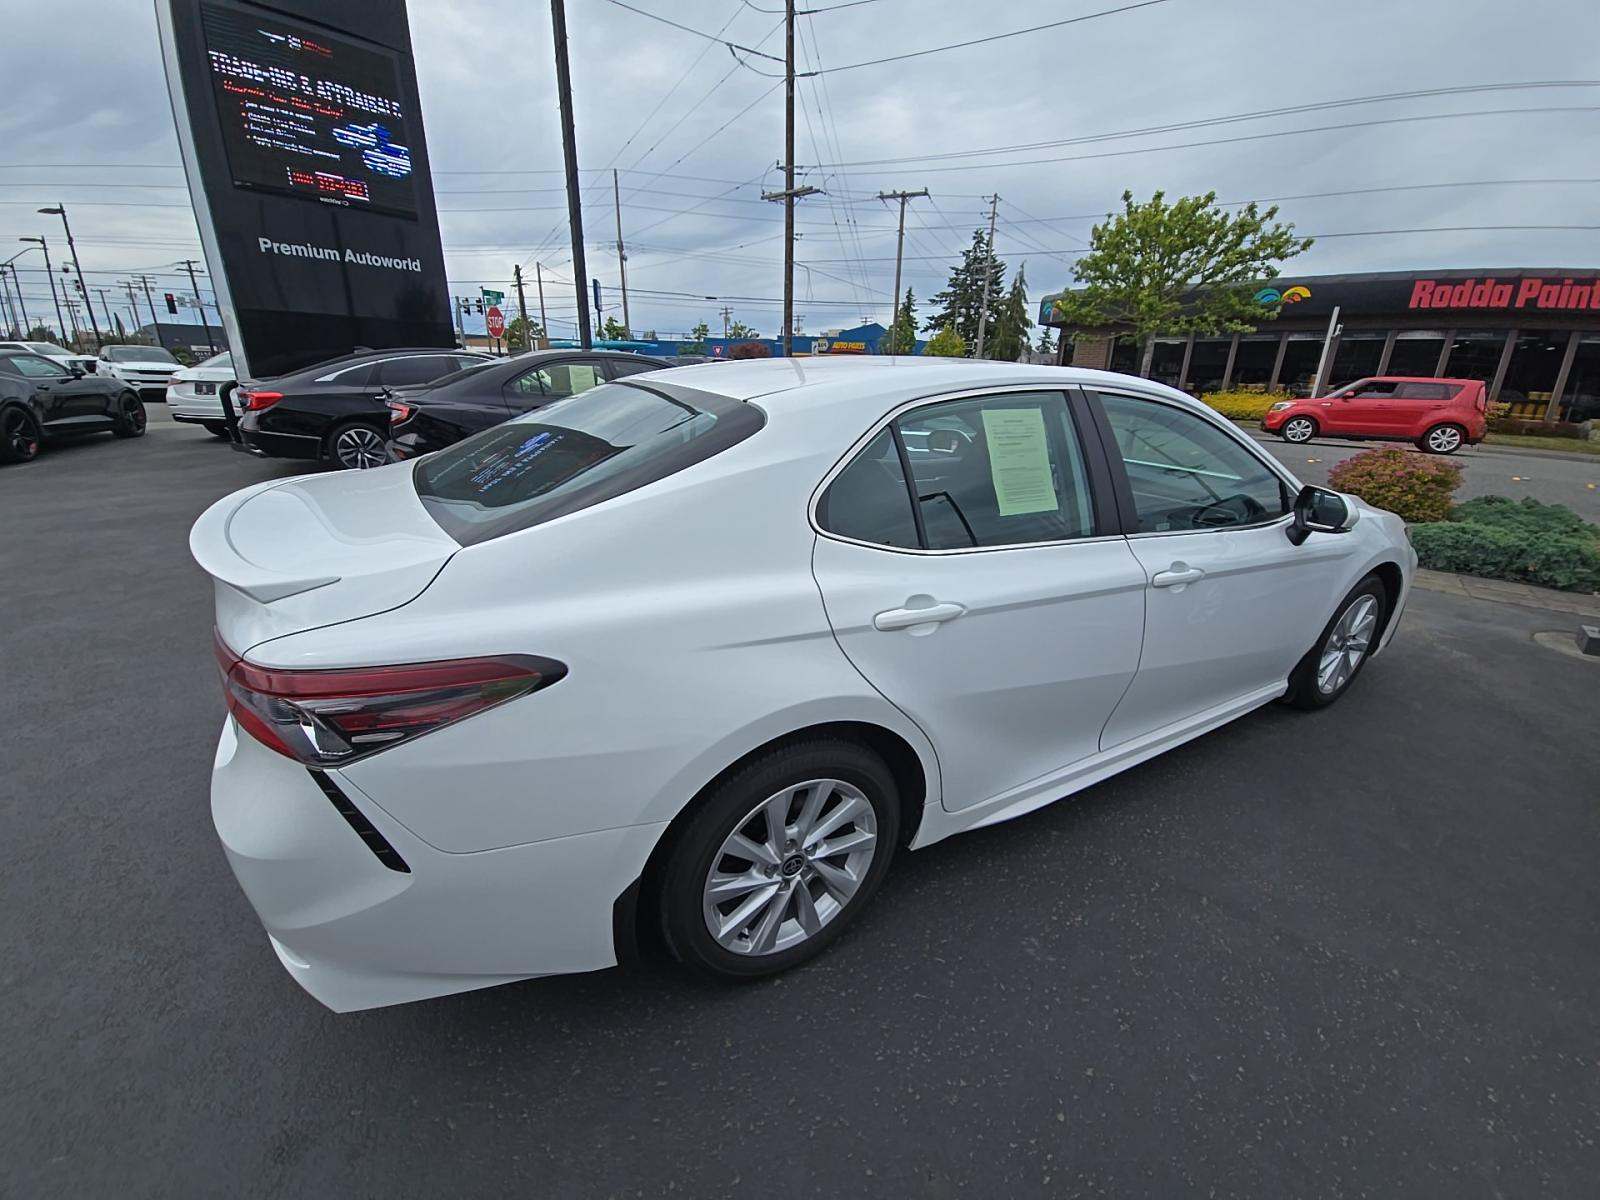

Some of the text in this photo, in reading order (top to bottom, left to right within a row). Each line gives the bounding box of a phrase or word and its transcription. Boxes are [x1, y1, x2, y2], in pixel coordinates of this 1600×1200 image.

[257, 237, 422, 272] Premium Autoworld
[1408, 278, 1600, 309] Rodda Paint
[488, 316, 503, 329] STOP
[831, 341, 848, 349] AUTO
[848, 341, 866, 350] PARTS
